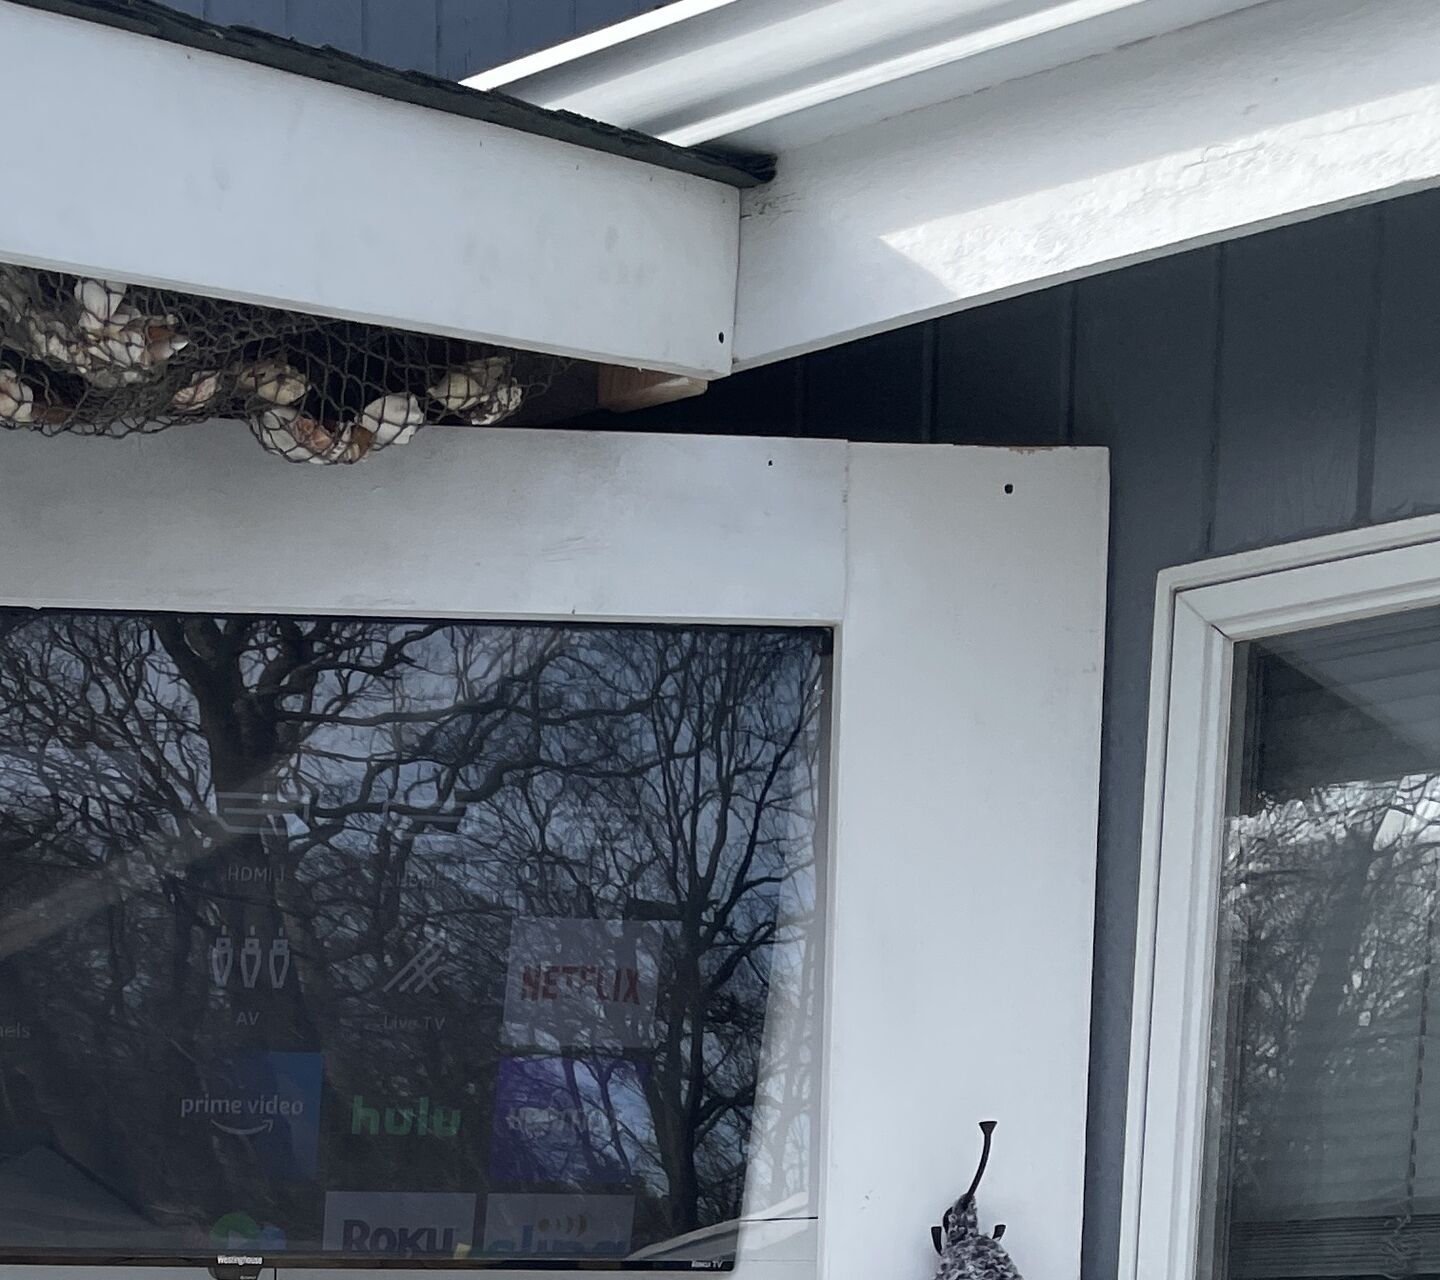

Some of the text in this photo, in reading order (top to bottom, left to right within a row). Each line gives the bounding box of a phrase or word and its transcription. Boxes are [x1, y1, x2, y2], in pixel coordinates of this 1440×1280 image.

[521, 963, 642, 1007] NETFLIX
[235, 1011, 260, 1027] AV
[420, 1015, 446, 1032] TV
[179, 1094, 305, 1119] prime video
[349, 1095, 462, 1138] hulu
